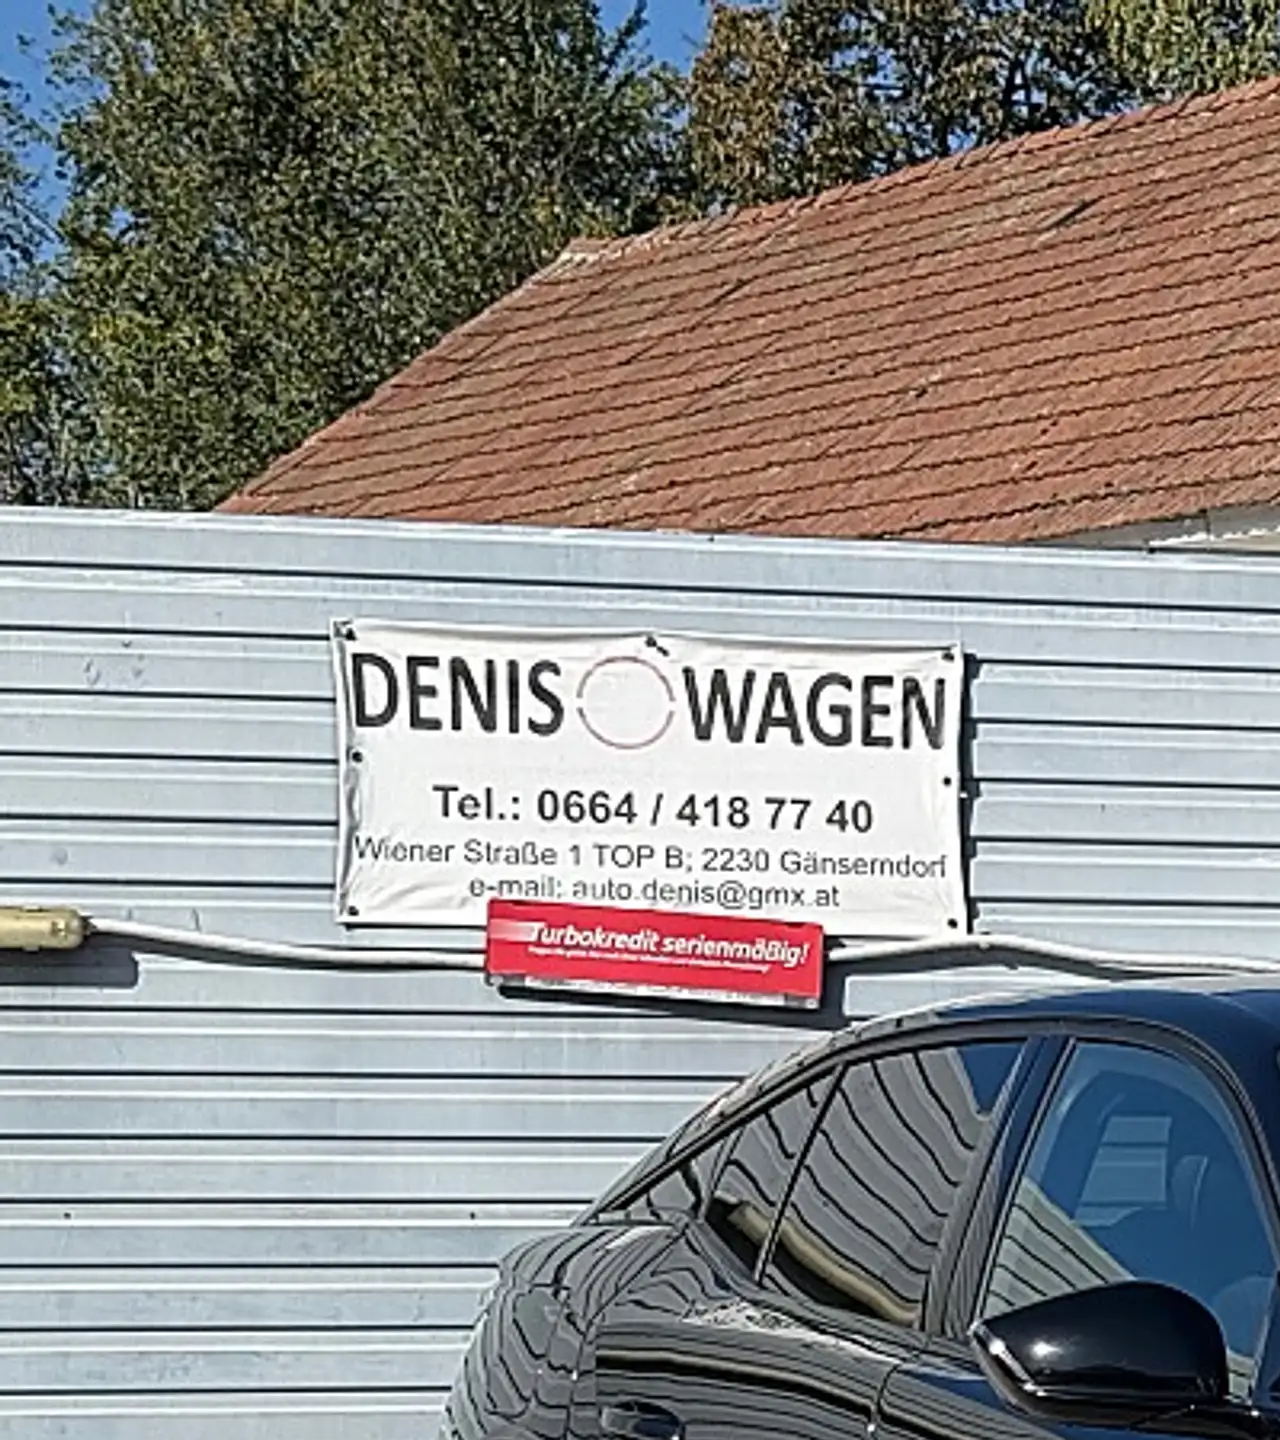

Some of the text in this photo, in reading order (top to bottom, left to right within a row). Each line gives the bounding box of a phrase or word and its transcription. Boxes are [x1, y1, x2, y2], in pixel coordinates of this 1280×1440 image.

[351, 653, 945, 750] DENIS WAGEN
[432, 784, 873, 833] Tel.: 0664 / 418 77 40
[355, 835, 455, 863] Wiener
[463, 839, 557, 866] Straße
[568, 844, 581, 866] 1
[593, 843, 655, 868] TOP
[702, 848, 770, 873] 2230
[780, 849, 948, 878] Gänserndorf
[572, 876, 840, 910] auto.denis@gmx.at
[529, 921, 662, 952] Turbokredit
